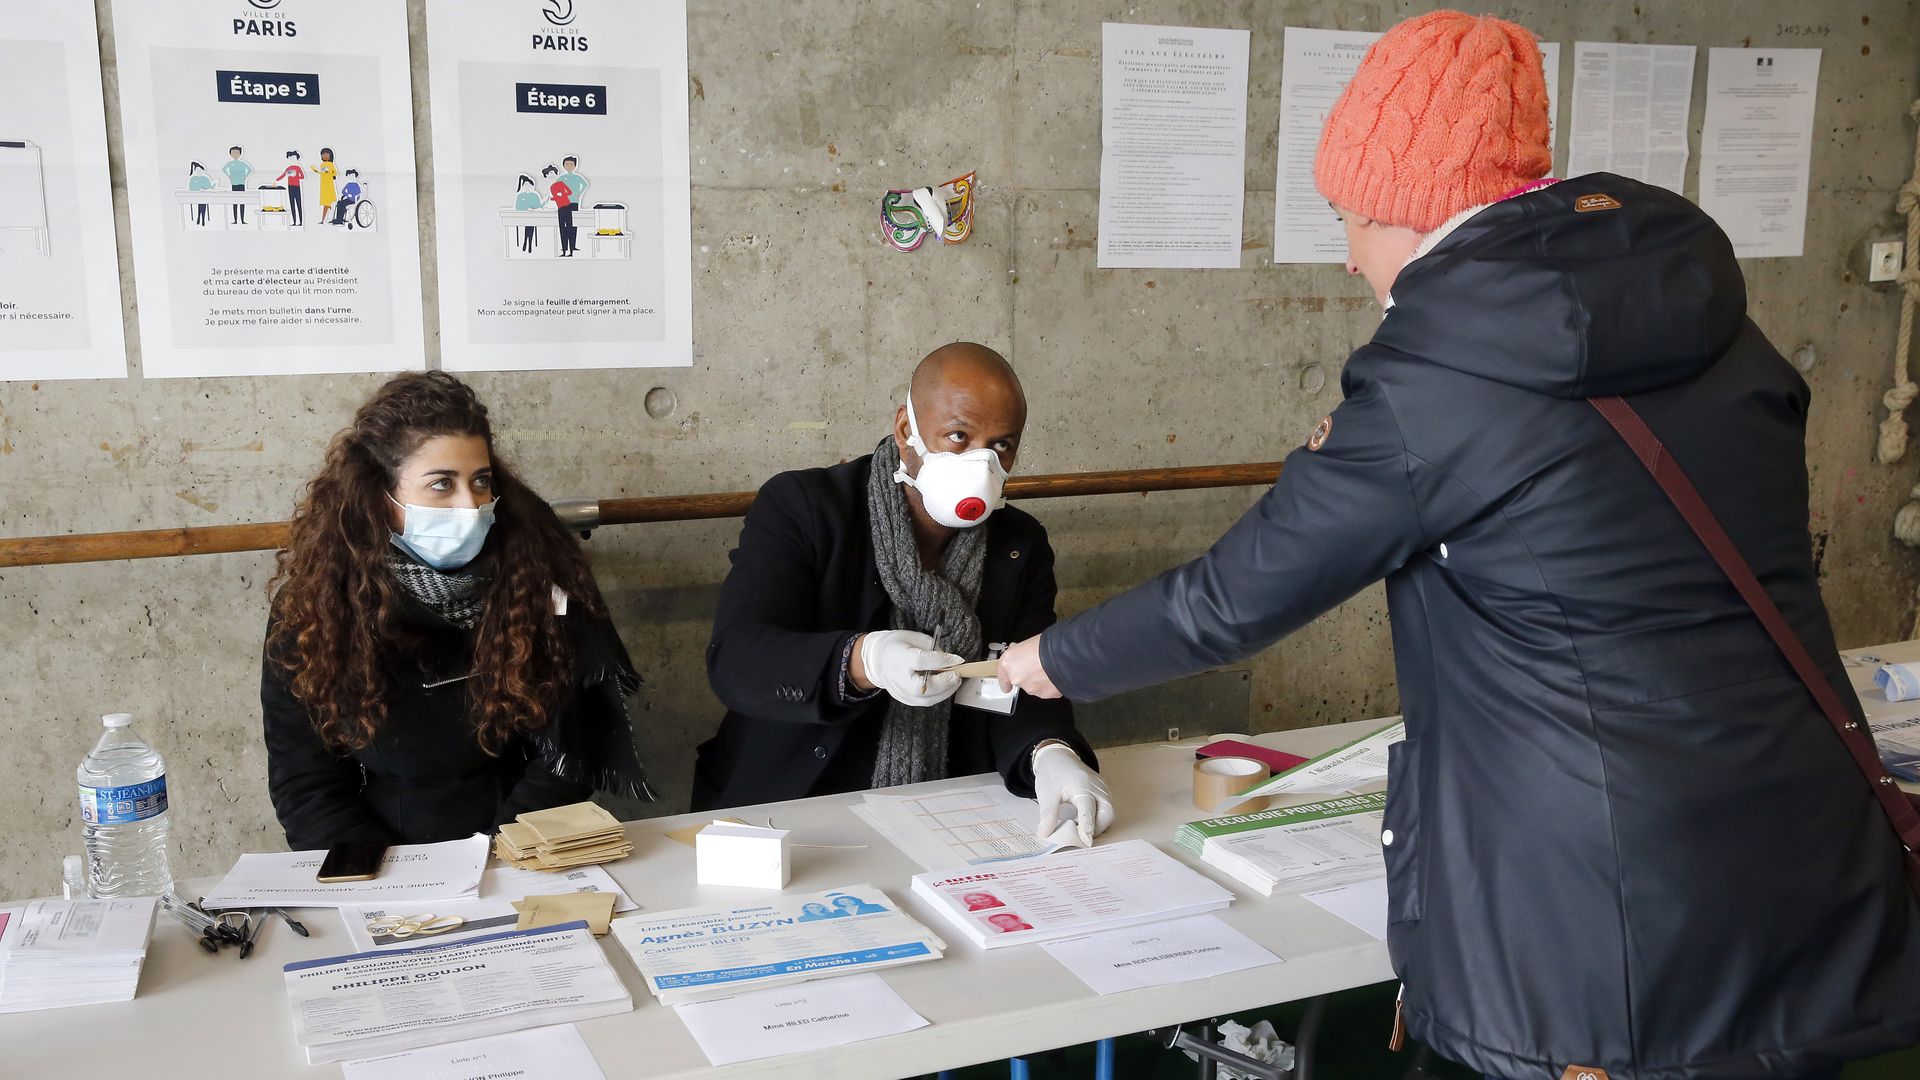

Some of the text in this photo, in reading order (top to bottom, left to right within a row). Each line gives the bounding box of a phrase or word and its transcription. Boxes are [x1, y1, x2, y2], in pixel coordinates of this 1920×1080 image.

[233, 18, 297, 37] PARIS
[532, 34, 589, 52] PARIS
[230, 75, 308, 100] Étape 5
[527, 87, 596, 111] Étape 6
[211, 268, 222, 276] Je
[224, 268, 264, 277] présente
[307, 267, 350, 275] d'identité
[203, 278, 213, 286] et
[231, 278, 255, 286] carte
[257, 278, 302, 286] d'électeur
[317, 277, 358, 285] Président
[203, 288, 215, 296] du
[217, 288, 249, 296] bureau
[286, 288, 301, 296] qui
[302, 287, 311, 295] lit
[503, 299, 512, 307] Je
[514, 299, 535, 308] signe
[546, 298, 570, 306] feuille
[572, 298, 631, 308] d'émargement.
[9, 312, 17, 320] si
[19, 312, 74, 320] nécessaire.
[209, 308, 220, 316] Je
[269, 307, 303, 315] bulletin
[304, 307, 326, 315] dans
[327, 306, 354, 314] l'urne.
[497, 309, 565, 317] accompagnateur
[566, 308, 585, 317] peut
[586, 308, 610, 316] signer
[633, 308, 656, 316] place.
[205, 318, 216, 326] Je
[218, 319, 240, 327] peux
[280, 317, 303, 325] aider
[314, 316, 362, 324] nécessaire.
[1283, 803, 1326, 817] POUR
[1324, 796, 1371, 810] PARIS
[1368, 793, 1387, 802] 15
[672, 918, 724, 929] Ensemble
[728, 914, 752, 922] pour
[640, 930, 705, 945] Agnès
[712, 917, 794, 934] BUZYN
[644, 941, 708, 955] Catherine
[710, 936, 750, 946] IBLED
[300, 966, 350, 979] PHILIPPE
[352, 960, 400, 970] GOUJON
[402, 956, 435, 964] VOTRE
[439, 950, 470, 960] MAIRE
[474, 936, 560, 953] PASSIONNÉMENT
[346, 964, 418, 976] RASSEMBLEMENT
[446, 954, 478, 963] DROITE
[504, 944, 536, 953] CENTRE
[805, 959, 852, 969] Marche
[332, 963, 486, 991] PHILIPPE GOUJON
[382, 980, 412, 988] MAIRE
[786, 1018, 810, 1027] IBLED
[811, 1013, 850, 1023] Catherine
[488, 1070, 524, 1080] Philippe
